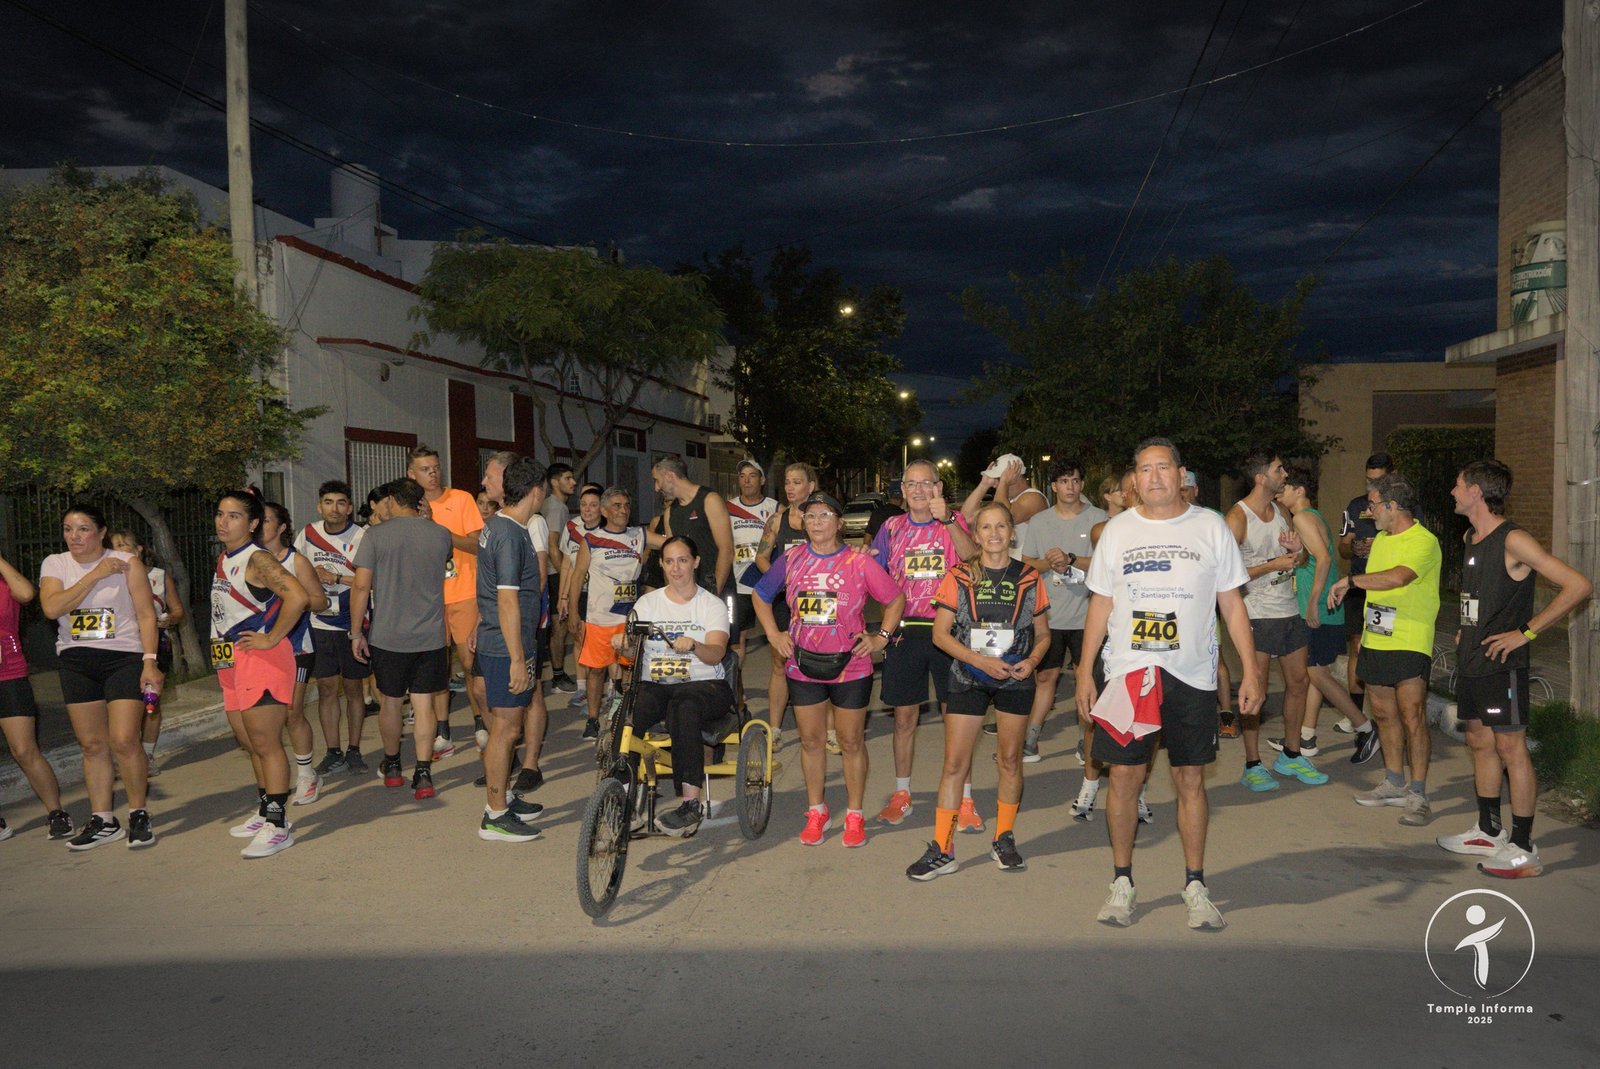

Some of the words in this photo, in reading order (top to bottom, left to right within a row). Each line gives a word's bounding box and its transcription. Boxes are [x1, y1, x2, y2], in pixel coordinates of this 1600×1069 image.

[1123, 549, 1201, 562] MARATÓN
[907, 556, 943, 572] 442
[1123, 560, 1172, 575] 2026
[614, 585, 637, 597] 448
[1141, 592, 1171, 600] Santiago
[1171, 592, 1194, 600] Temple
[799, 598, 836, 615] 443
[72, 615, 113, 631] 428
[1372, 610, 1382, 625] 3
[1133, 620, 1178, 641] 440
[985, 630, 998, 648] 2
[211, 643, 233, 661] 430
[650, 661, 688, 676] 434
